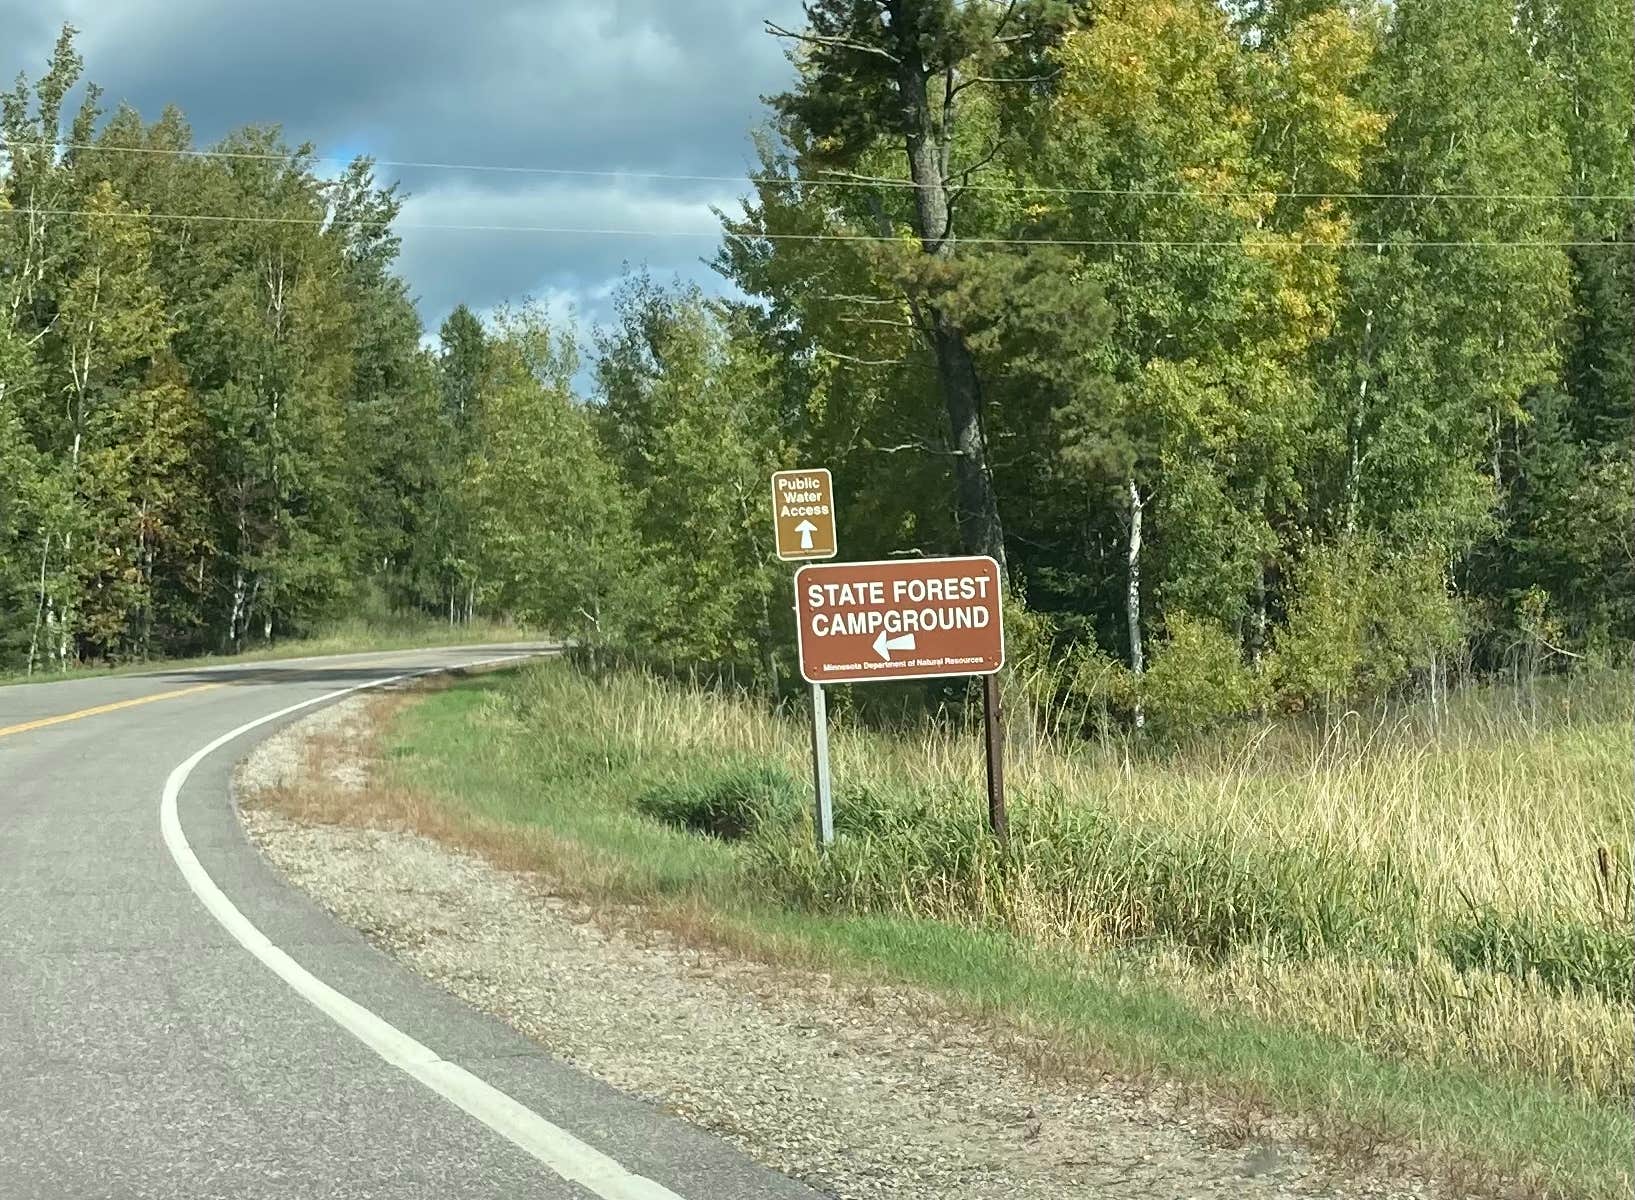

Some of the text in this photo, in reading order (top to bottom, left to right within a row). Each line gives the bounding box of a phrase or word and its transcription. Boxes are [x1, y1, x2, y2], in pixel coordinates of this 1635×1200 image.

[778, 477, 820, 491] Public
[783, 491, 823, 504] Water
[781, 505, 829, 517] Access
[808, 576, 990, 608] STATE FOREST
[812, 605, 989, 637] CAMPGROUND
[823, 656, 984, 671] Minnesota Department of Natural Resources
